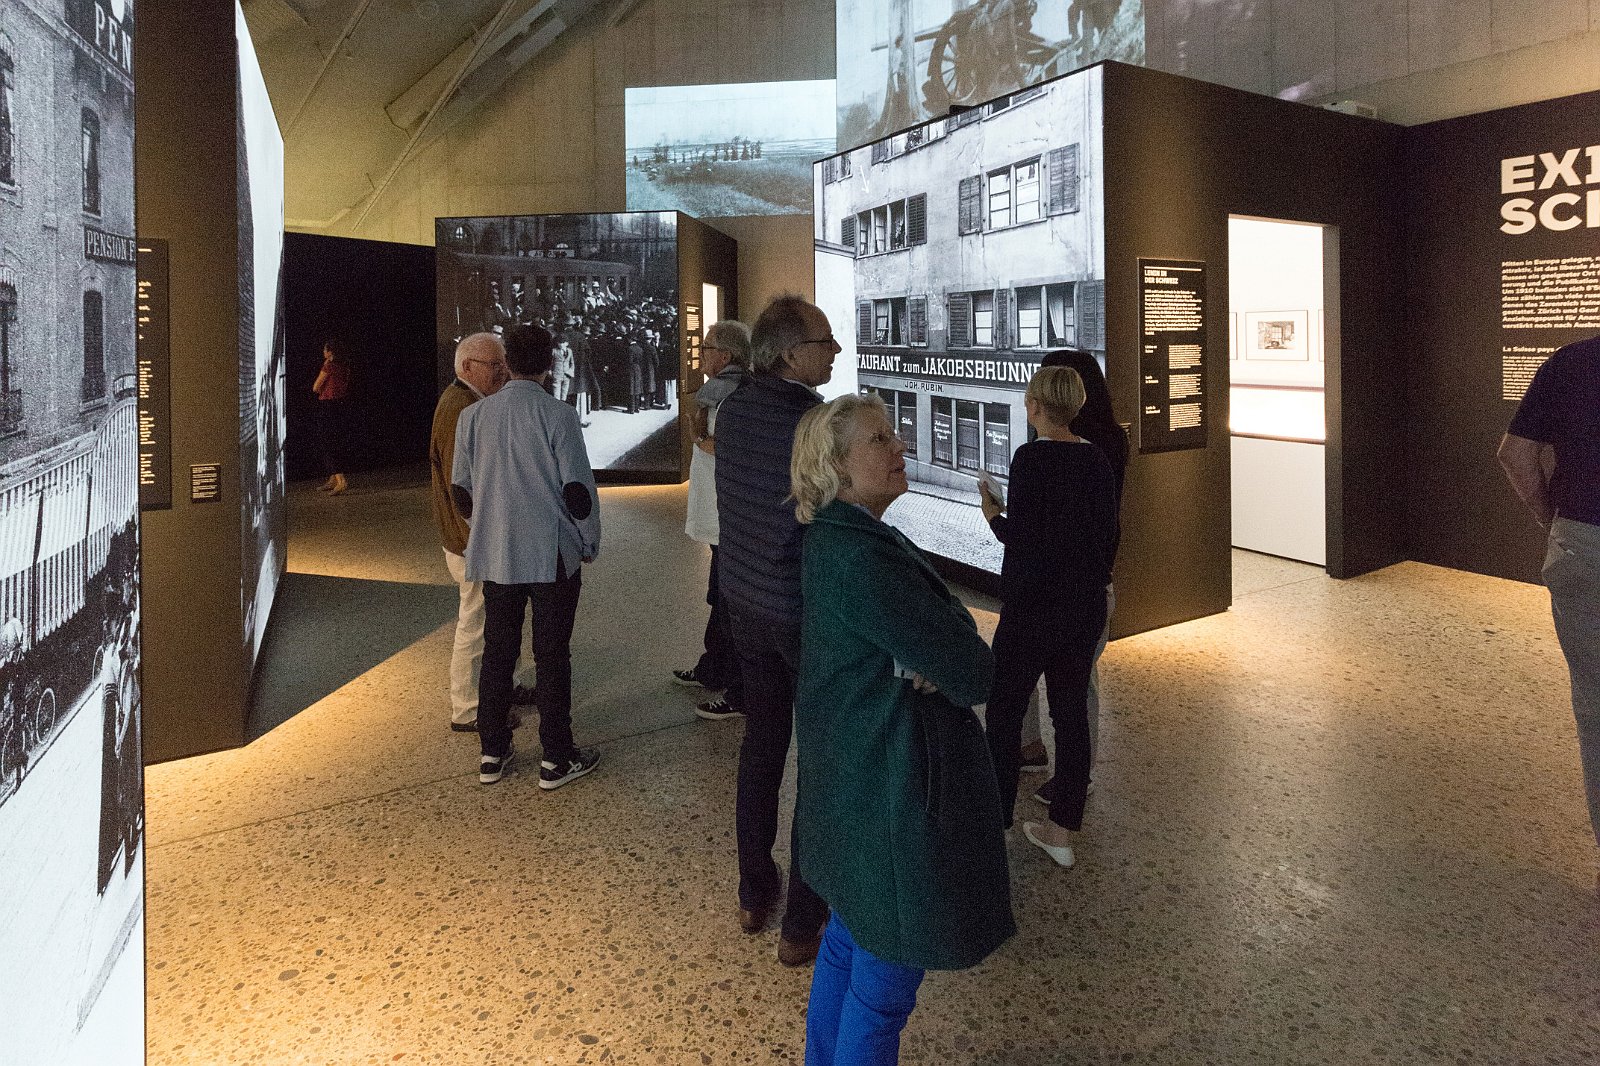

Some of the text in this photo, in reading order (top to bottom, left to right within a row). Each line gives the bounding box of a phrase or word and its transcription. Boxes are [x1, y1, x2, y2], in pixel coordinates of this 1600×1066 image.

[87, 230, 127, 261] PENSION
[903, 363, 920, 373] zum
[905, 381, 920, 390] JOH.
